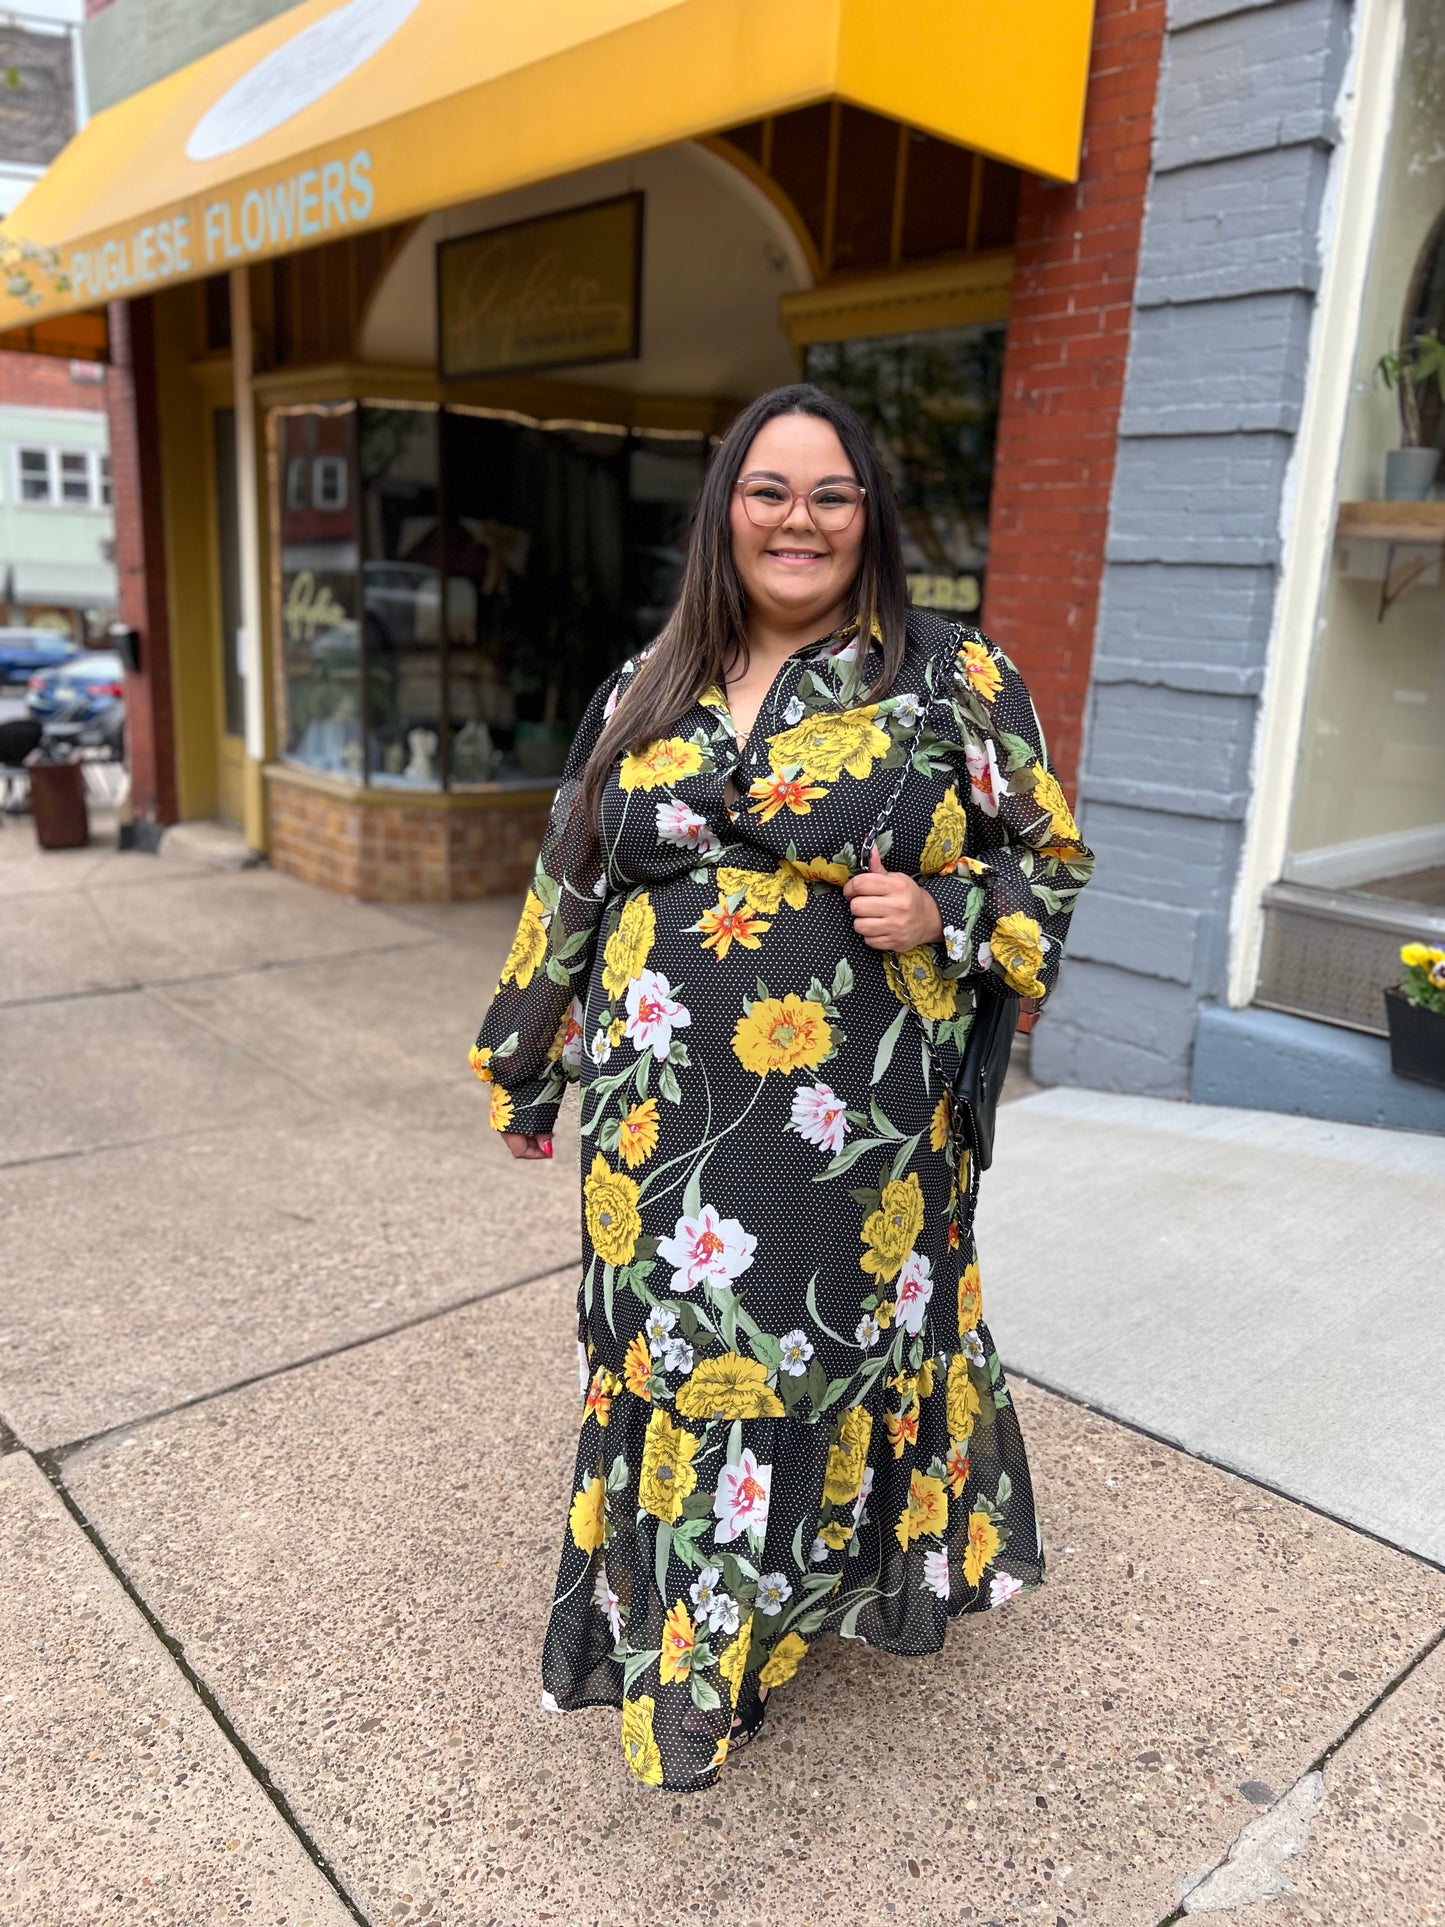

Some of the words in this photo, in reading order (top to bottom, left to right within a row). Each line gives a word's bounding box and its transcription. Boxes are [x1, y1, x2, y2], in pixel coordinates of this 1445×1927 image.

[71, 214, 192, 301] PUGLIESE
[204, 150, 375, 264] FLOWERS
[905, 574, 980, 612] ERS
